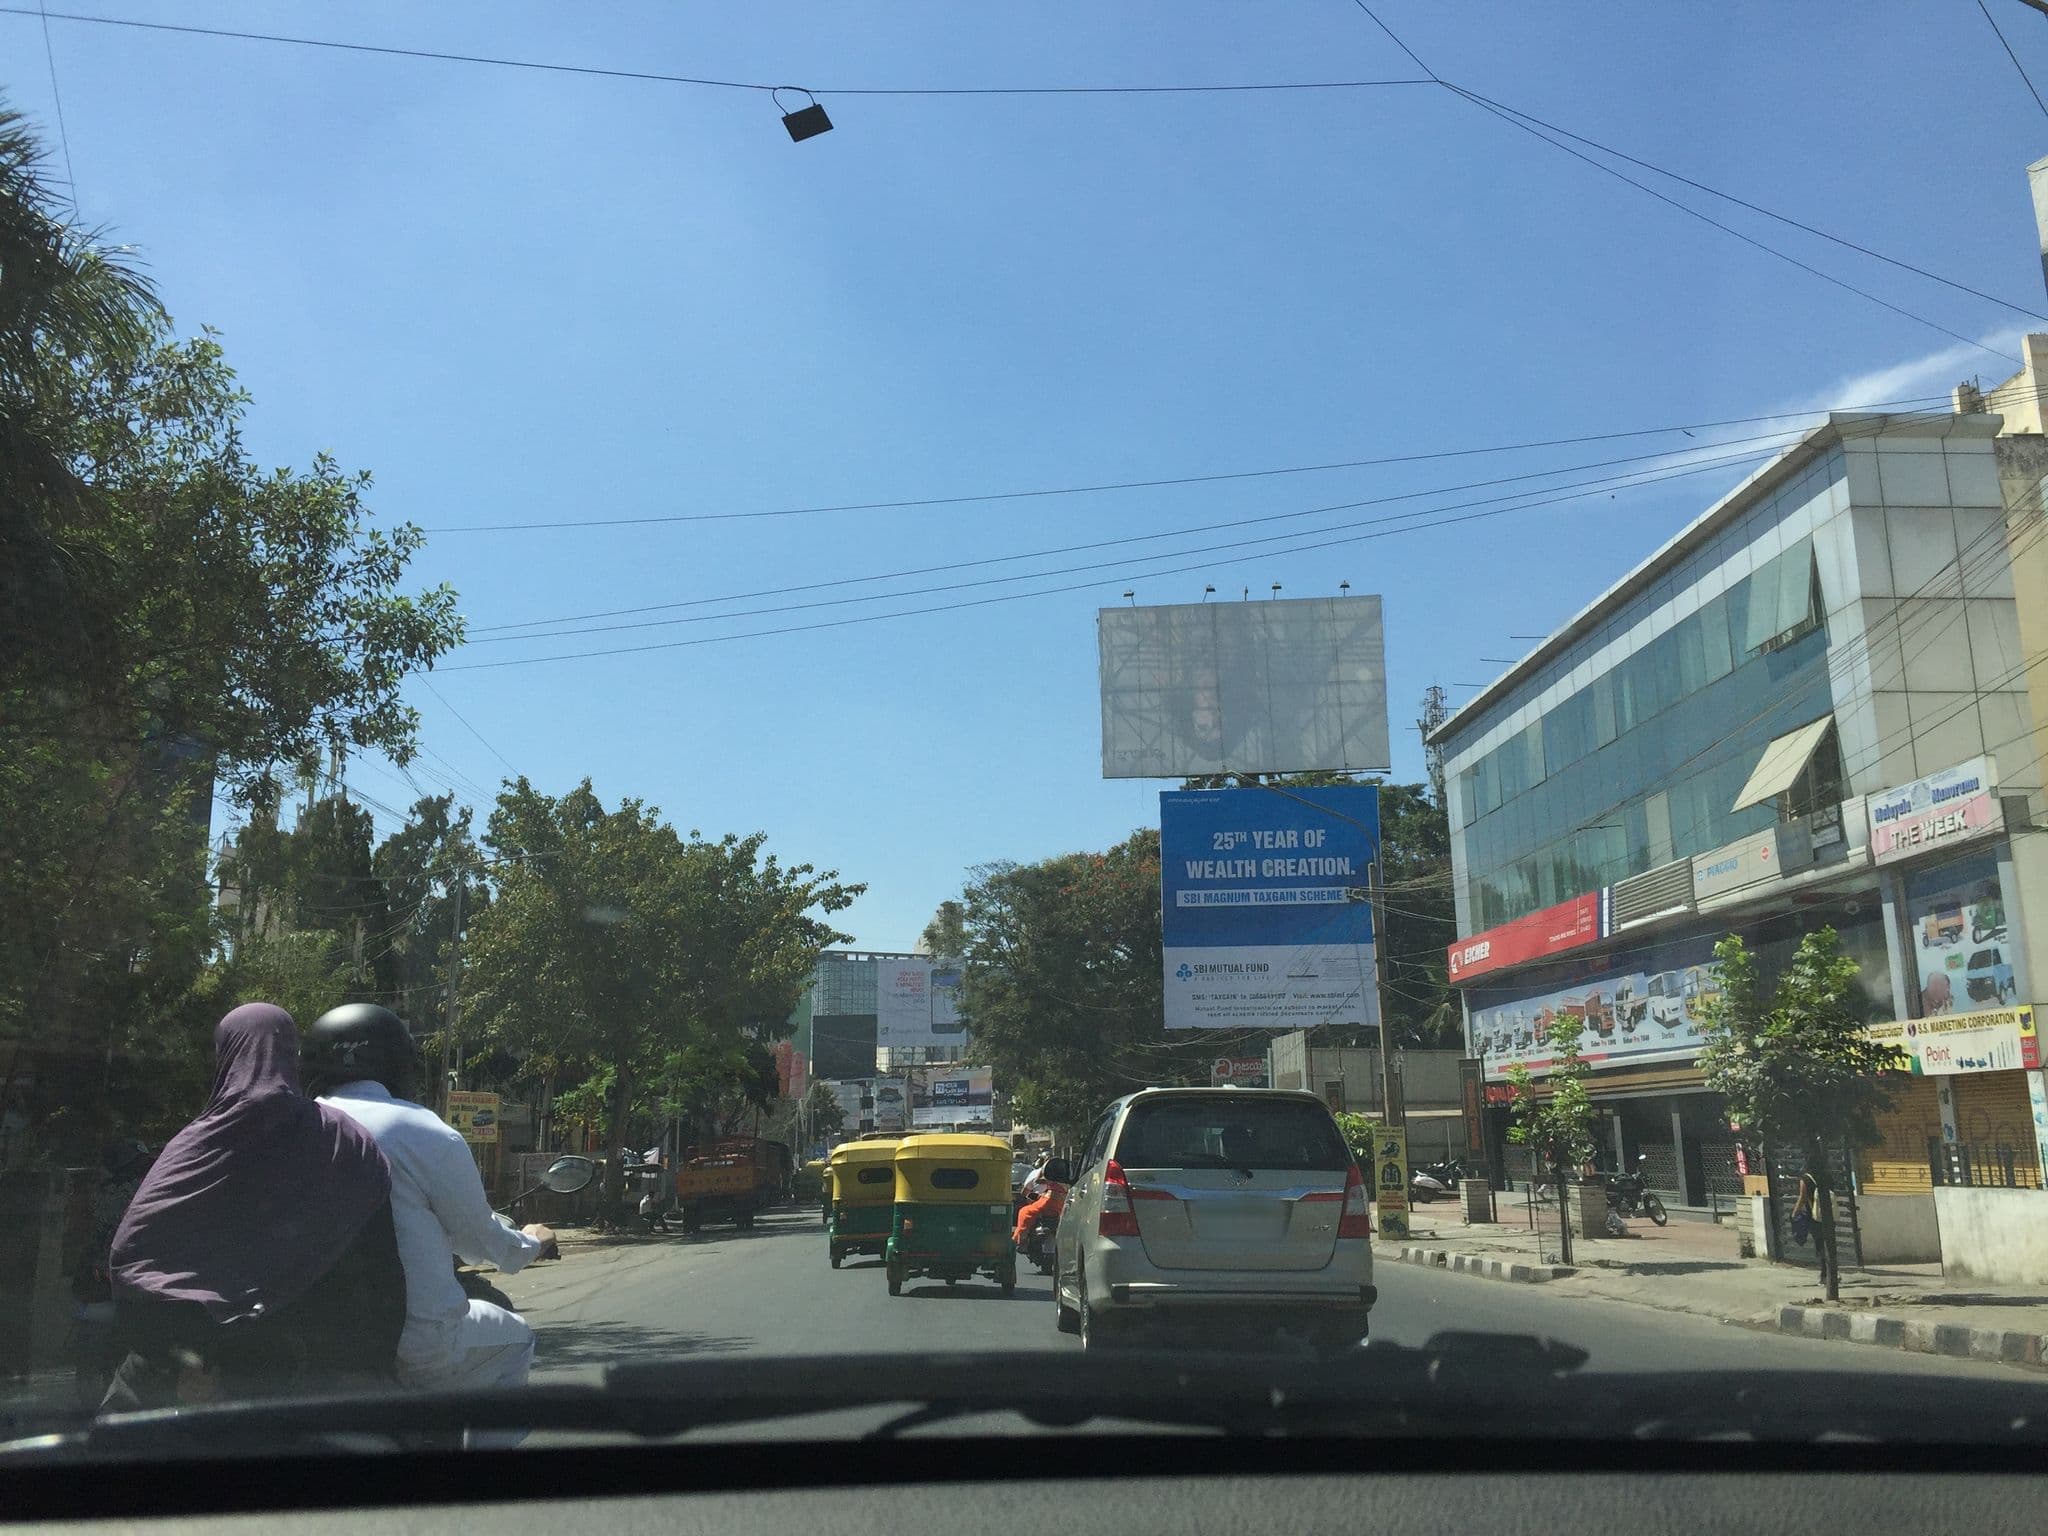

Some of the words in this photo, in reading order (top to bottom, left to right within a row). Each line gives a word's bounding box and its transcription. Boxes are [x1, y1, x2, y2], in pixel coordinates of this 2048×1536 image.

[1252, 830, 1298, 849] YEAR
[1304, 829, 1326, 848] OF
[1891, 825, 1921, 849] THE
[1921, 809, 1968, 841] WEEK
[1185, 859, 1256, 879] WEALTH
[1261, 857, 1356, 877] CREATION.
[1183, 894, 1201, 904] SBI
[1203, 892, 1250, 903] MAGNUM
[1253, 891, 1297, 902] TAXGAIN
[1300, 890, 1342, 901] SCHEME
[1464, 941, 1490, 965] EICHER
[1193, 964, 1208, 974] SBI
[1209, 964, 1244, 973] MUTUAL
[1246, 963, 1269, 973] FUND
[1930, 1017, 1967, 1032] MARKETING
[1968, 1012, 2016, 1028] CORPORATION
[1926, 1045, 1951, 1061] Point
